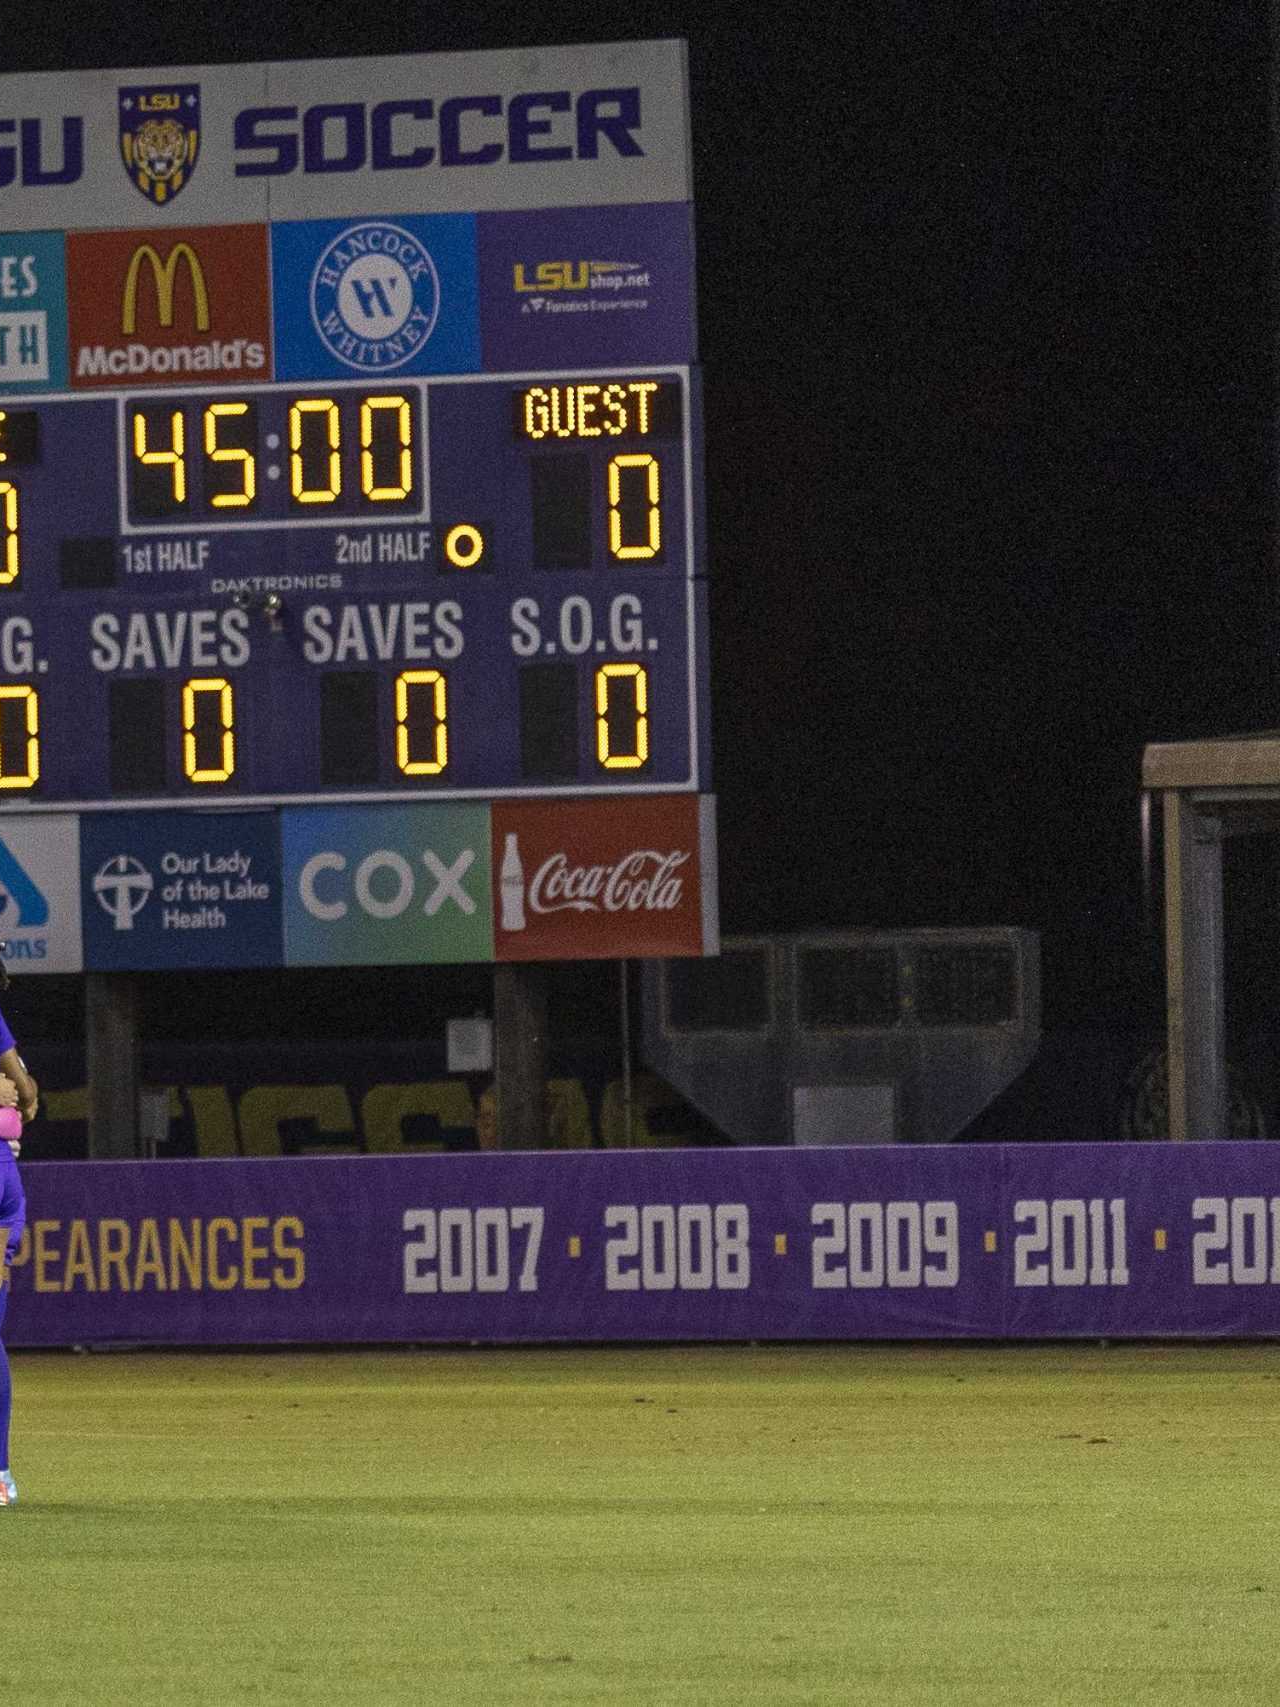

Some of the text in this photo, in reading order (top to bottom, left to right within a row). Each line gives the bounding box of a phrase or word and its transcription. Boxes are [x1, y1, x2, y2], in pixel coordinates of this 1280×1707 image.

[140, 93, 180, 111] LSU
[234, 87, 645, 177] SOCCER
[321, 231, 429, 287] HANCOCK
[78, 338, 265, 376] McDonald's
[321, 304, 431, 363] WHITNEY
[525, 382, 658, 438] GUEST
[134, 396, 412, 508] 45:00
[608, 454, 660, 559] 0
[122, 540, 210, 573] 1st HALF
[336, 531, 431, 564] 2nd HALF
[211, 574, 343, 594] DAKTRONICS
[91, 609, 251, 671] SAVES
[303, 601, 465, 663] SAVES
[511, 595, 658, 655] S.O.G.
[182, 678, 235, 783] 0
[395, 669, 448, 775] 0
[595, 663, 649, 769] 0
[161, 850, 251, 877] Our Lady
[162, 878, 270, 902] of the Lake
[299, 850, 478, 920] COX
[529, 850, 691, 914] Coca-Cola
[163, 906, 226, 930] Health
[403, 1206, 545, 1293] 2007
[604, 1203, 751, 1290] 2008
[811, 1201, 959, 1288] 2009
[1014, 1198, 1129, 1286] 2011
